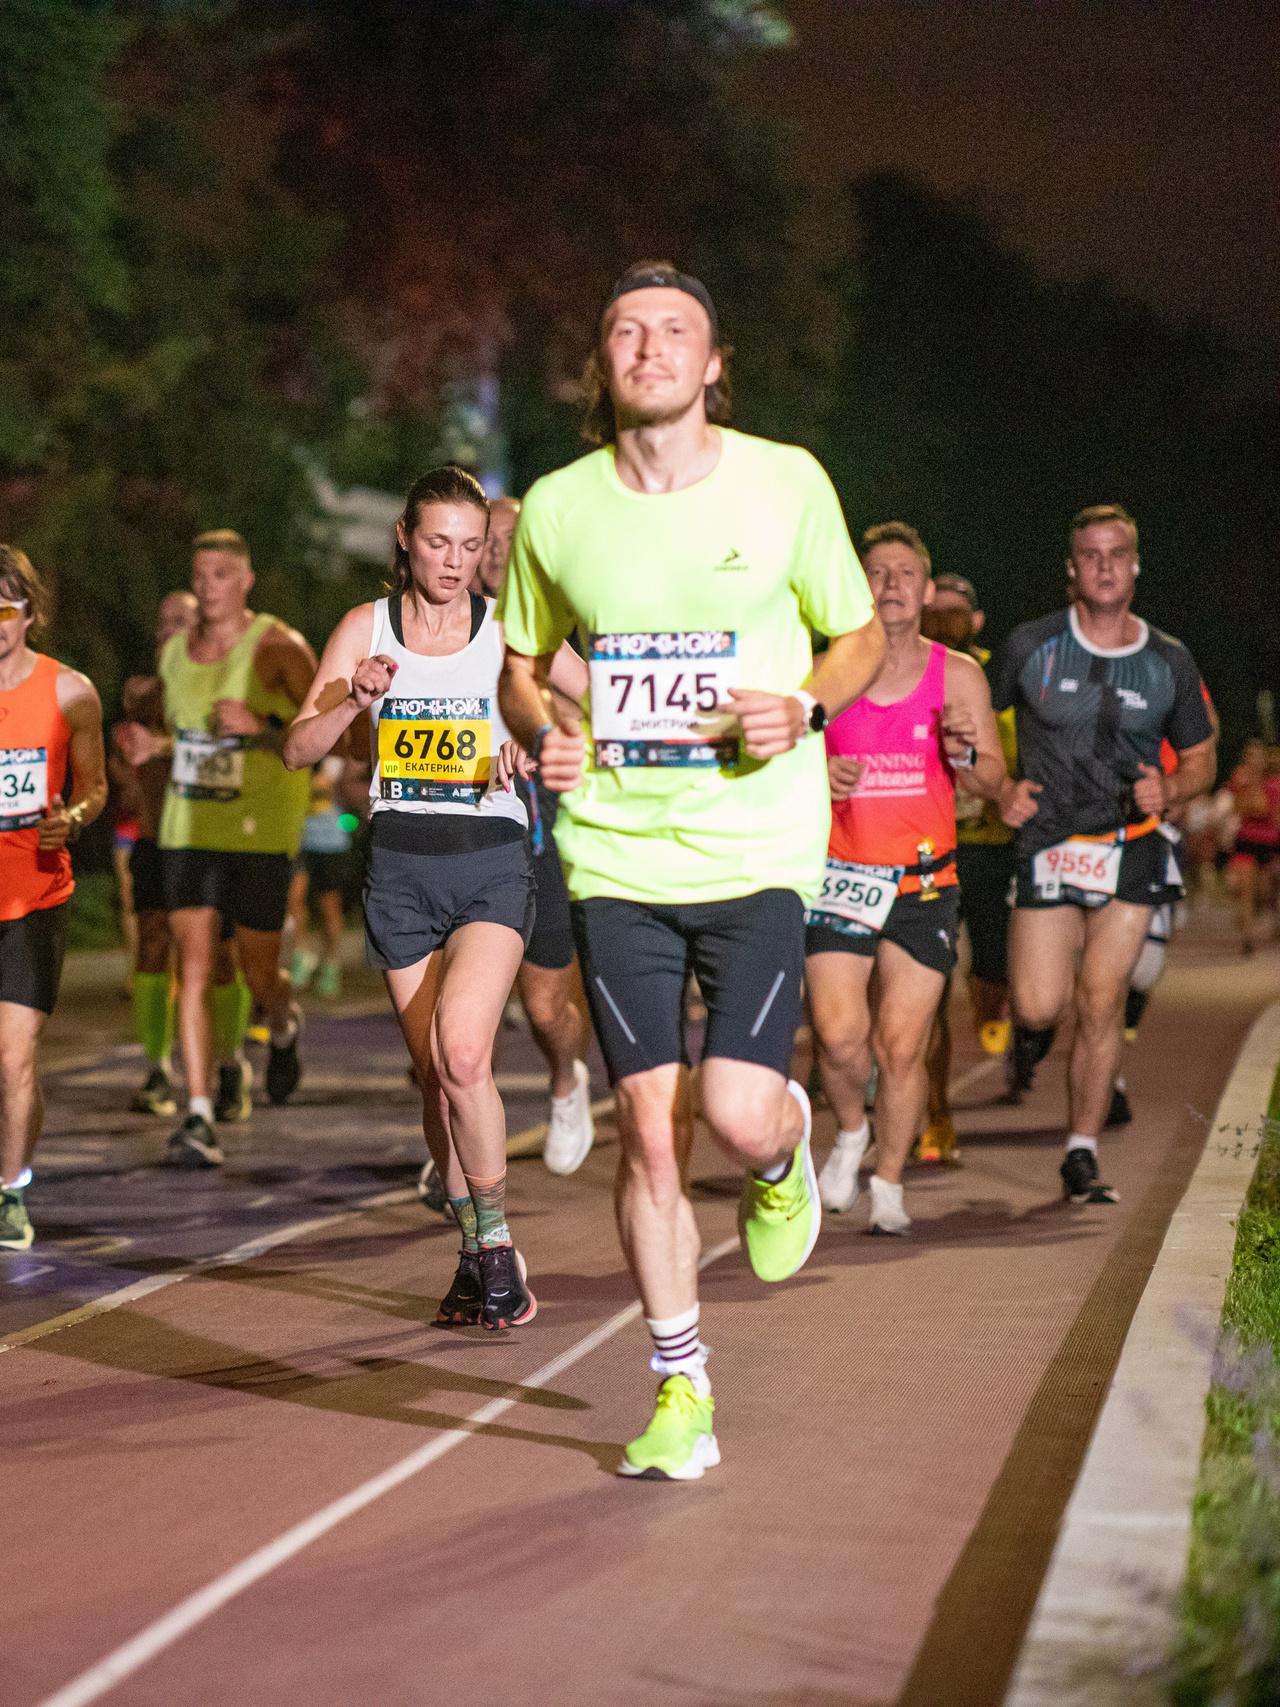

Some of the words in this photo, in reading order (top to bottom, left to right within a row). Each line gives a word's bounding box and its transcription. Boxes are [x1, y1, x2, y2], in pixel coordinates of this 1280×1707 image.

[610, 673, 718, 713] 7145
[392, 699, 483, 716] НОЧНОЙ
[394, 729, 477, 761] 6768
[385, 764, 399, 774] VIP
[405, 762, 465, 774] ЕКАТЕРИНА
[1046, 848, 1107, 880] 9556
